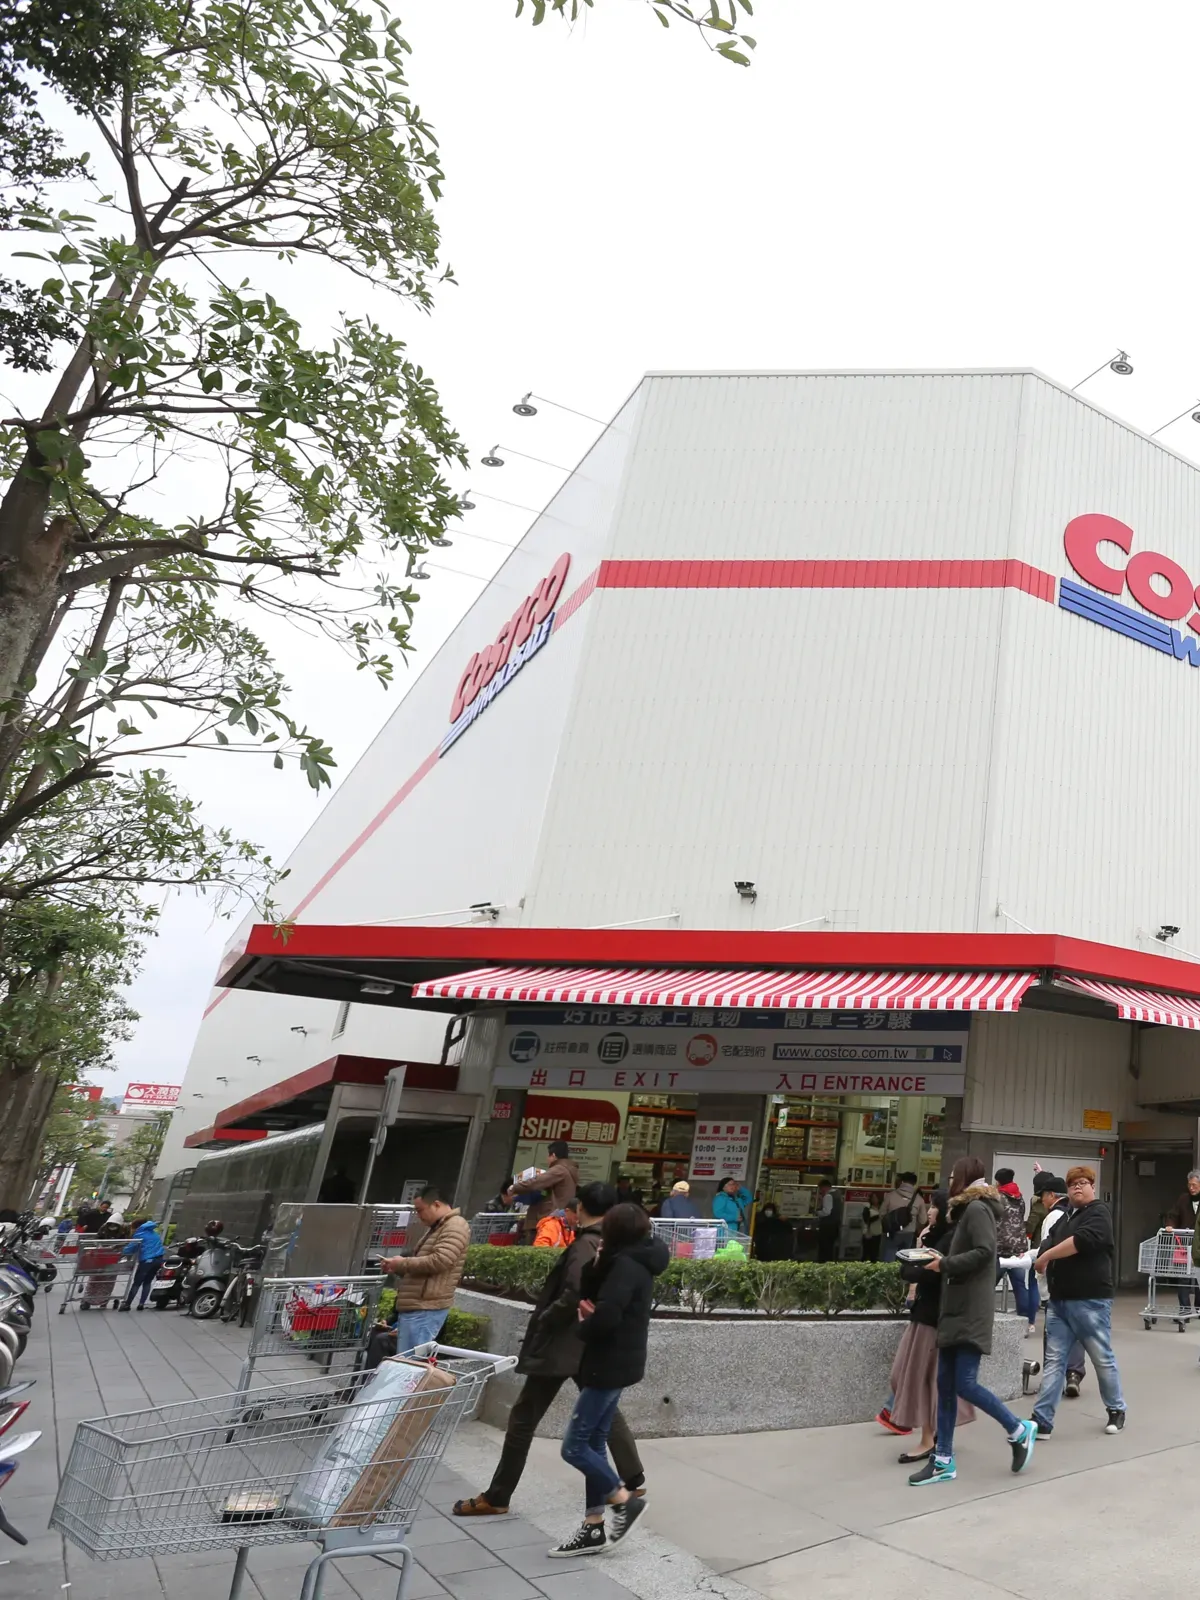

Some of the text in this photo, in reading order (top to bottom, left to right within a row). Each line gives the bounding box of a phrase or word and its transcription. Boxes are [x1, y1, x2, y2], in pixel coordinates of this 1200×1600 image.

[449, 552, 571, 724] COSTCO
[778, 1045, 909, 1060] www.costco.com.tw
[530, 1069, 586, 1086] 出口
[614, 1071, 680, 1087] EXIT
[776, 1073, 817, 1090] 入口
[823, 1075, 927, 1091] ENTRANCE
[144, 1086, 180, 1096] 大潤發
[571, 1120, 616, 1141] 會員部
[695, 1144, 716, 1152] 10:00
[726, 1145, 748, 1153] 21:30
